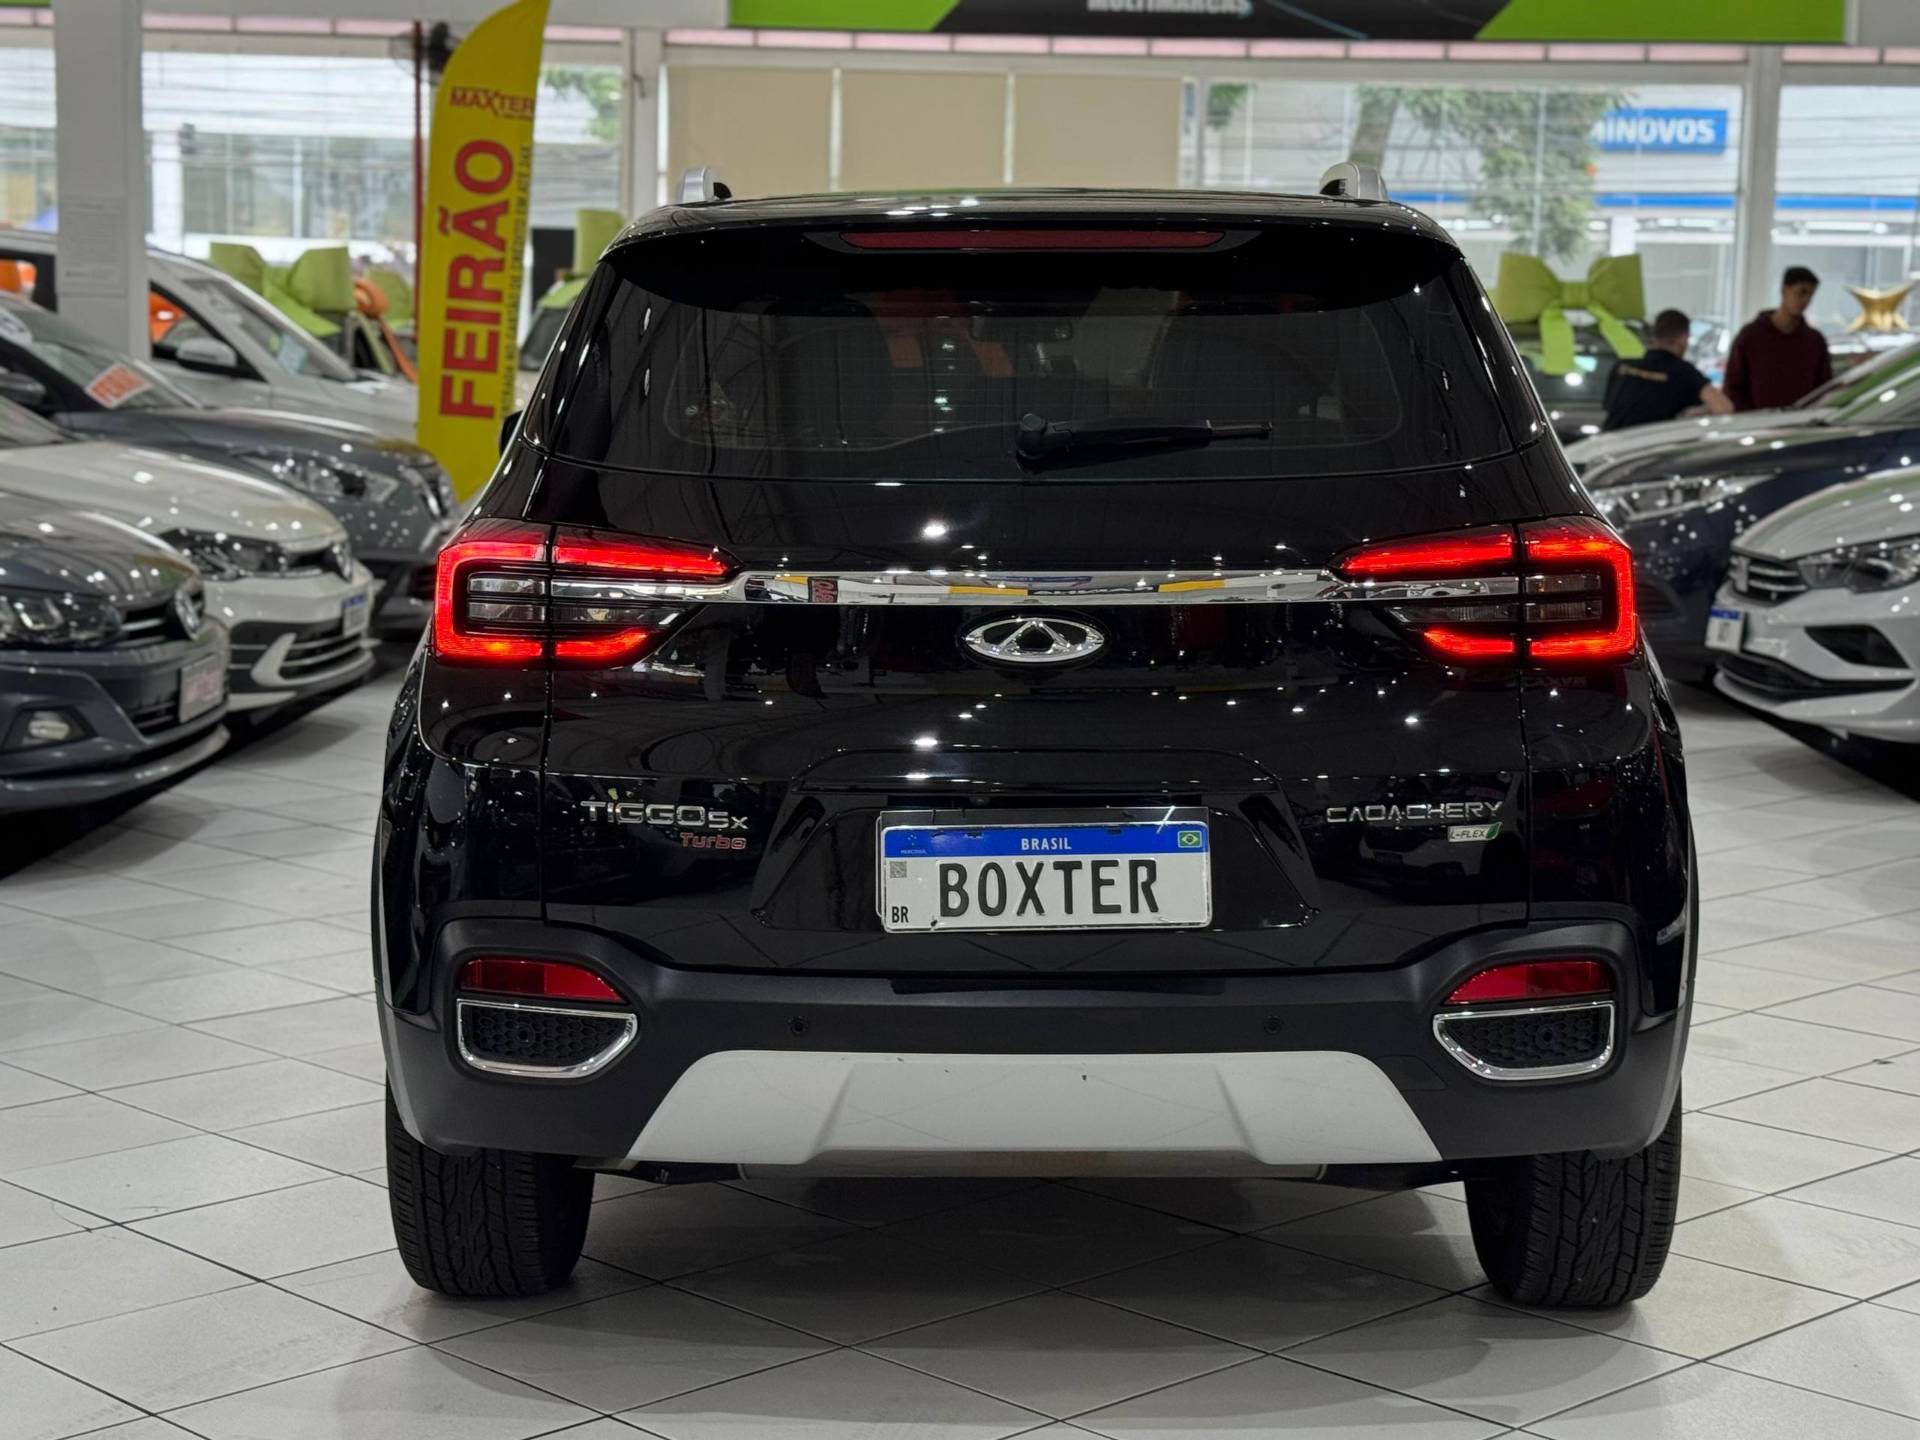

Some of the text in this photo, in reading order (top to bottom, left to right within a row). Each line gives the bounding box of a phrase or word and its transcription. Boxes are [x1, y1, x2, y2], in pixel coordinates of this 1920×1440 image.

[437, 138, 513, 418] FEIRÃO
[680, 832, 747, 850] Turbo
[1021, 838, 1072, 851] BRASIL
[938, 859, 1160, 918] BOXTER
[891, 905, 909, 923] BR
